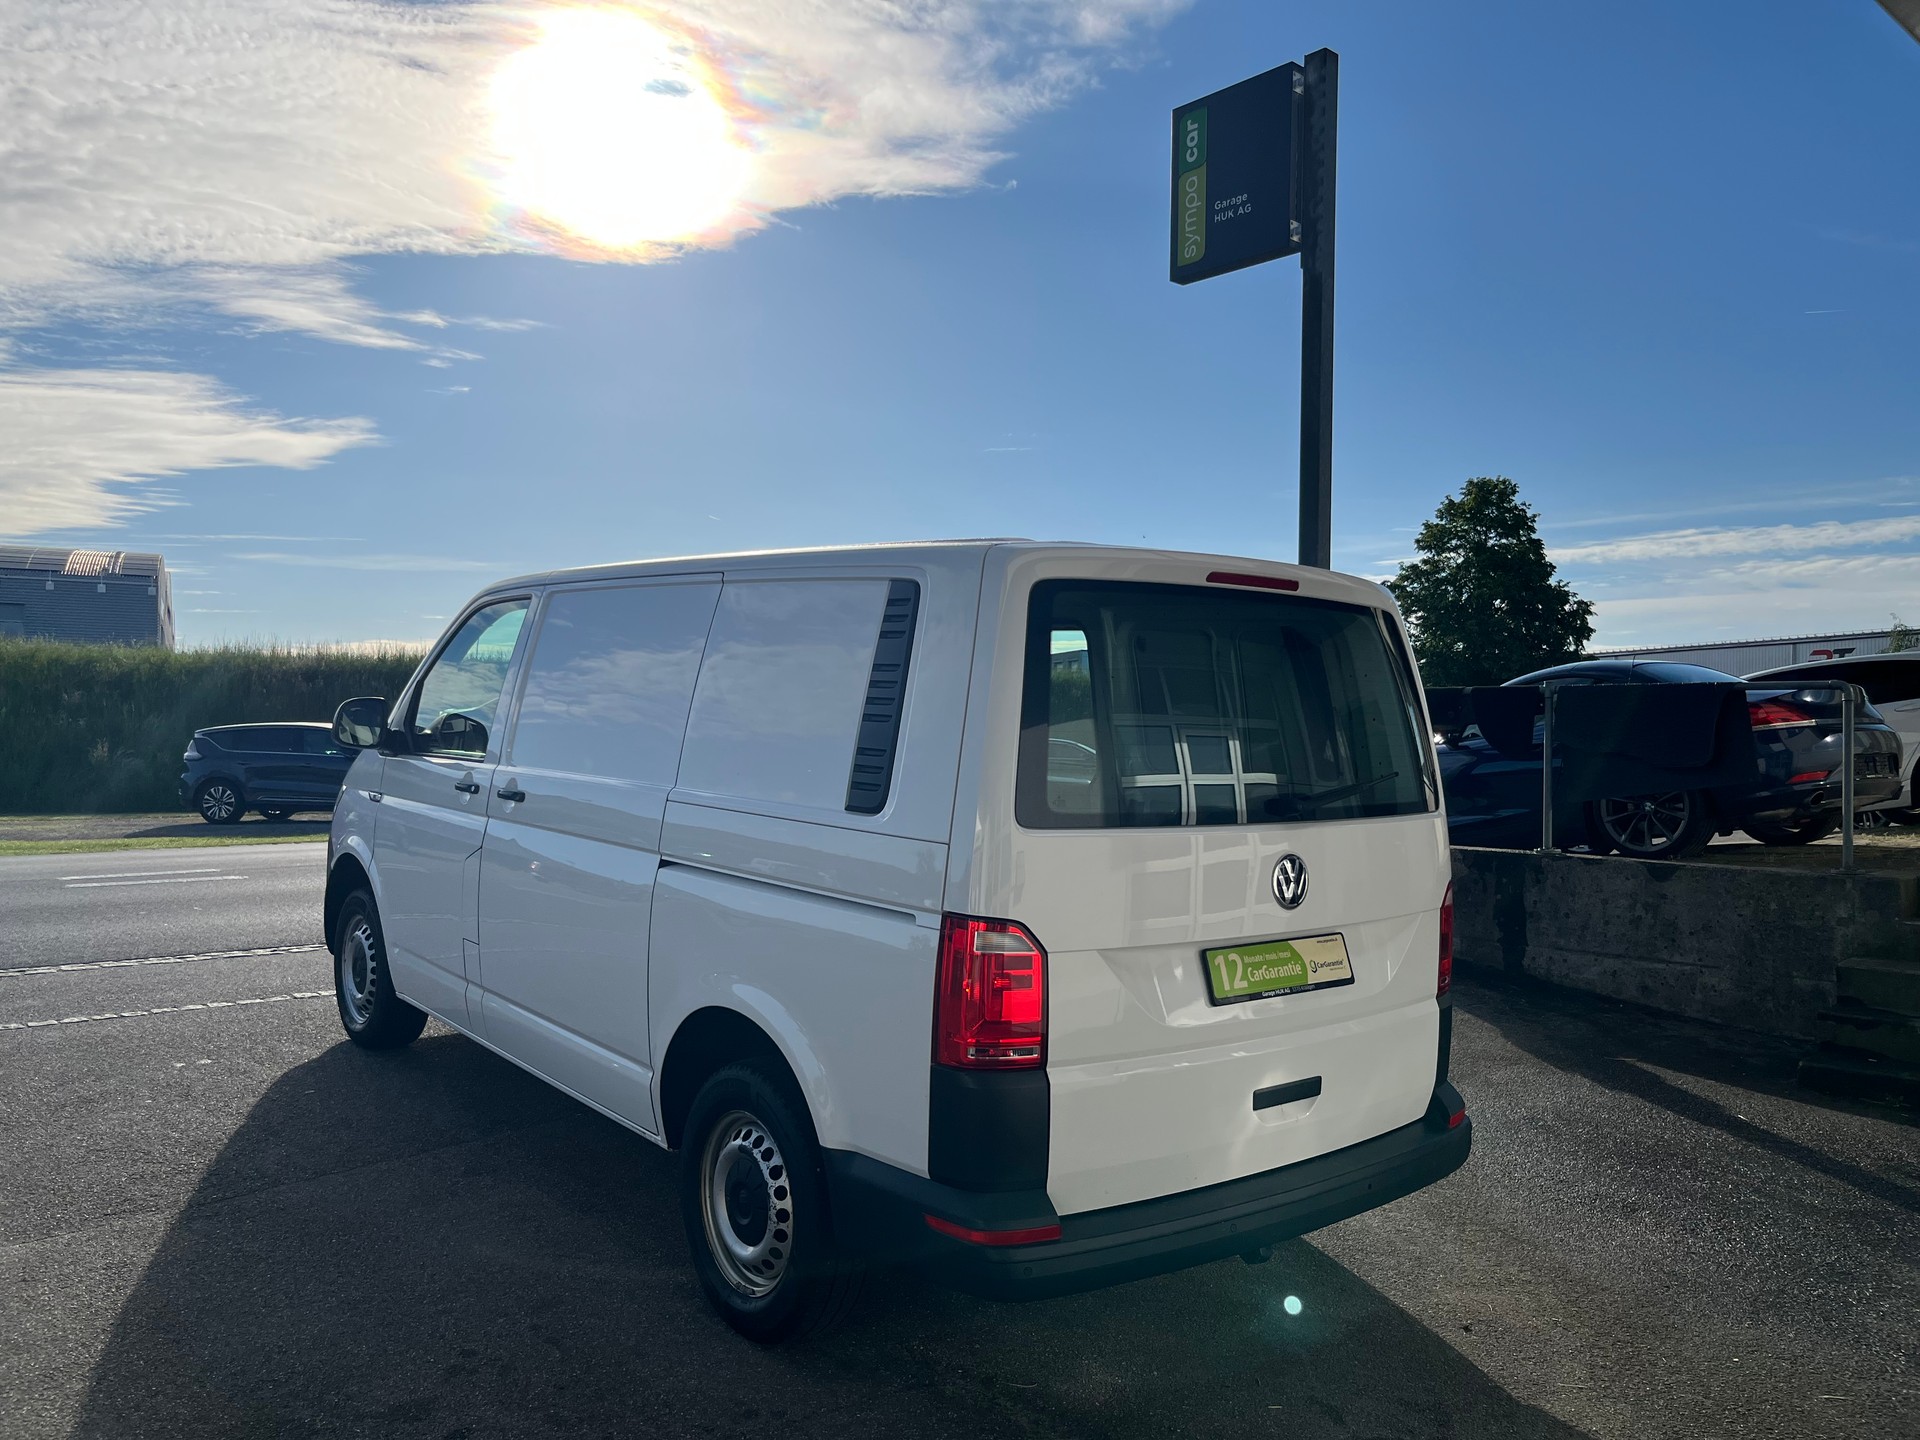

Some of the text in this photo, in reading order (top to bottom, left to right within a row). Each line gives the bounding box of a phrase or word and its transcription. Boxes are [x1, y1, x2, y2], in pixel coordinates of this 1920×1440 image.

[1184, 119, 1202, 259] sympa car
[1214, 193, 1248, 210] Garage
[1214, 203, 1252, 223] HUK AG
[1214, 952, 1249, 991] 12
